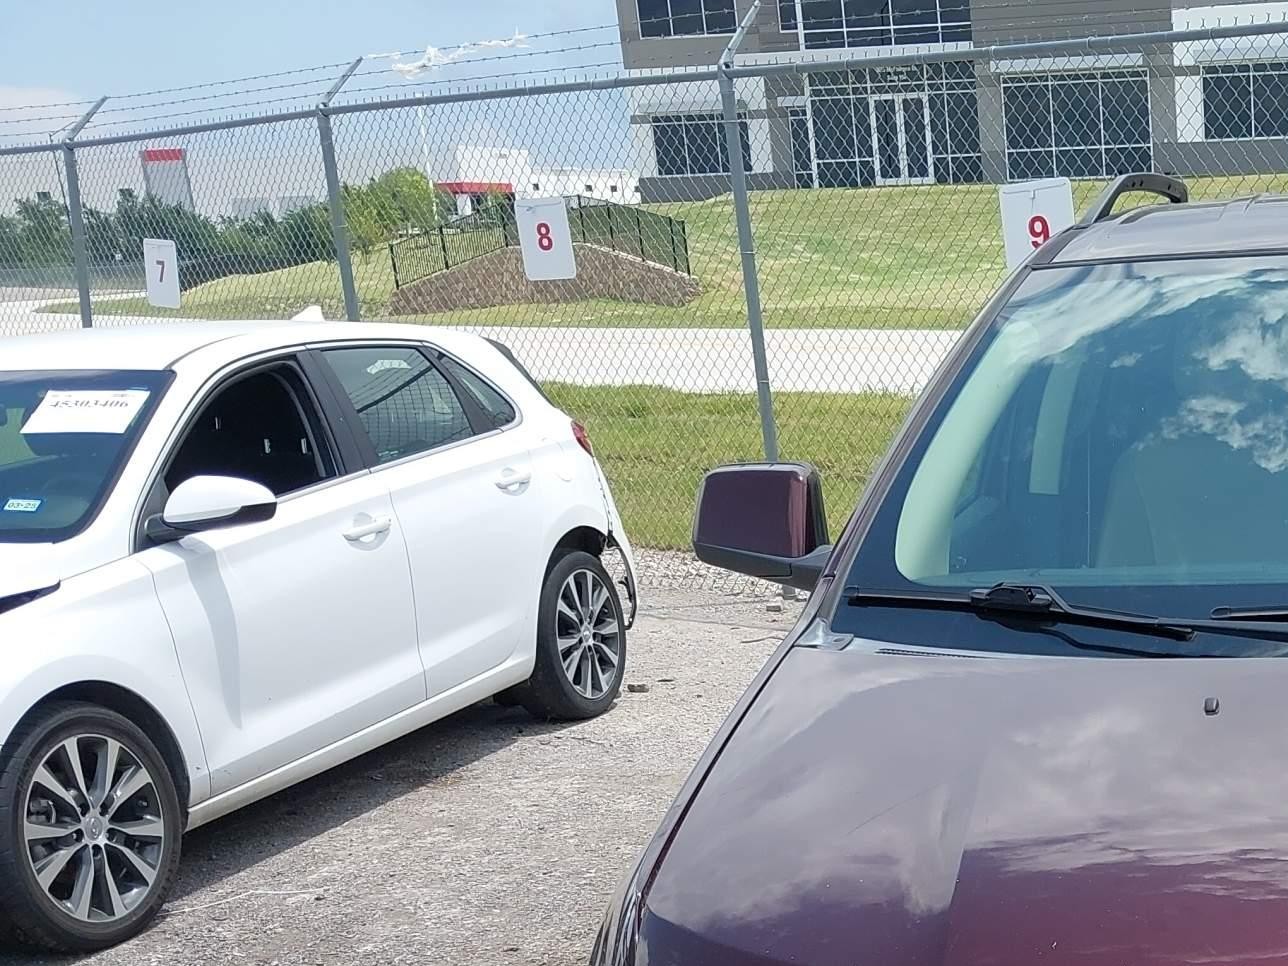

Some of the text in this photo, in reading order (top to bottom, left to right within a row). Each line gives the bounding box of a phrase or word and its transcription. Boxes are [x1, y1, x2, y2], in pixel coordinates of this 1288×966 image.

[536, 222, 553, 251] 8
[1028, 215, 1050, 249] 9
[155, 260, 165, 283] 7
